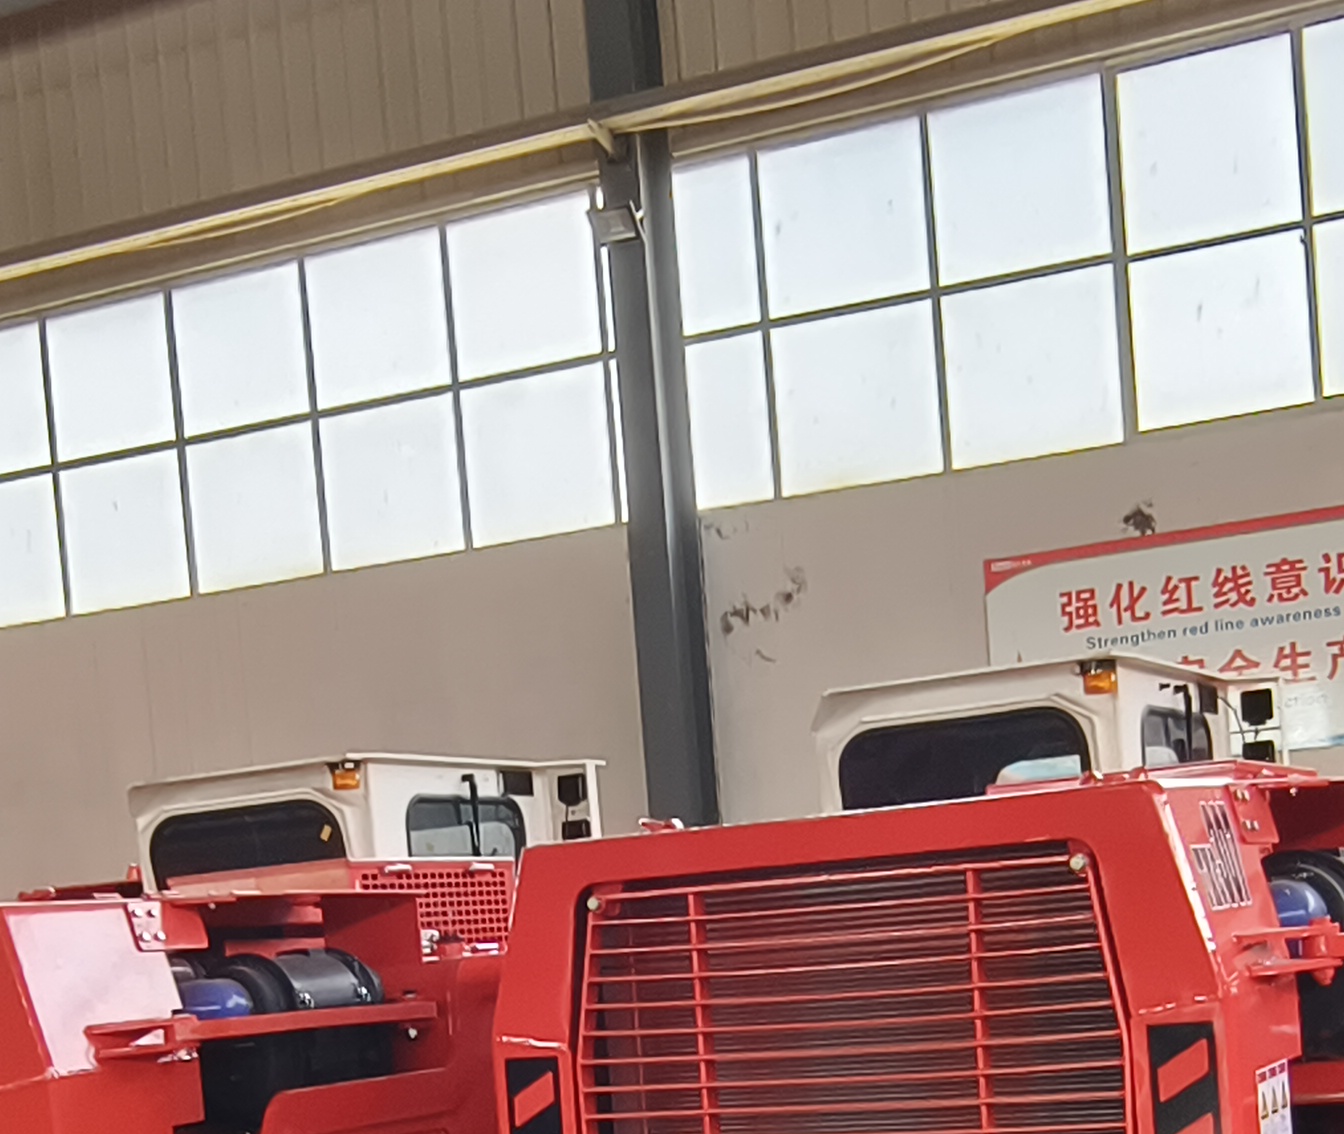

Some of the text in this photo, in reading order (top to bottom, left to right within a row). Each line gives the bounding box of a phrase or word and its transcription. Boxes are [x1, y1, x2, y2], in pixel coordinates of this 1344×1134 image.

[1086, 605, 1342, 650] Strengthen red line awareness
